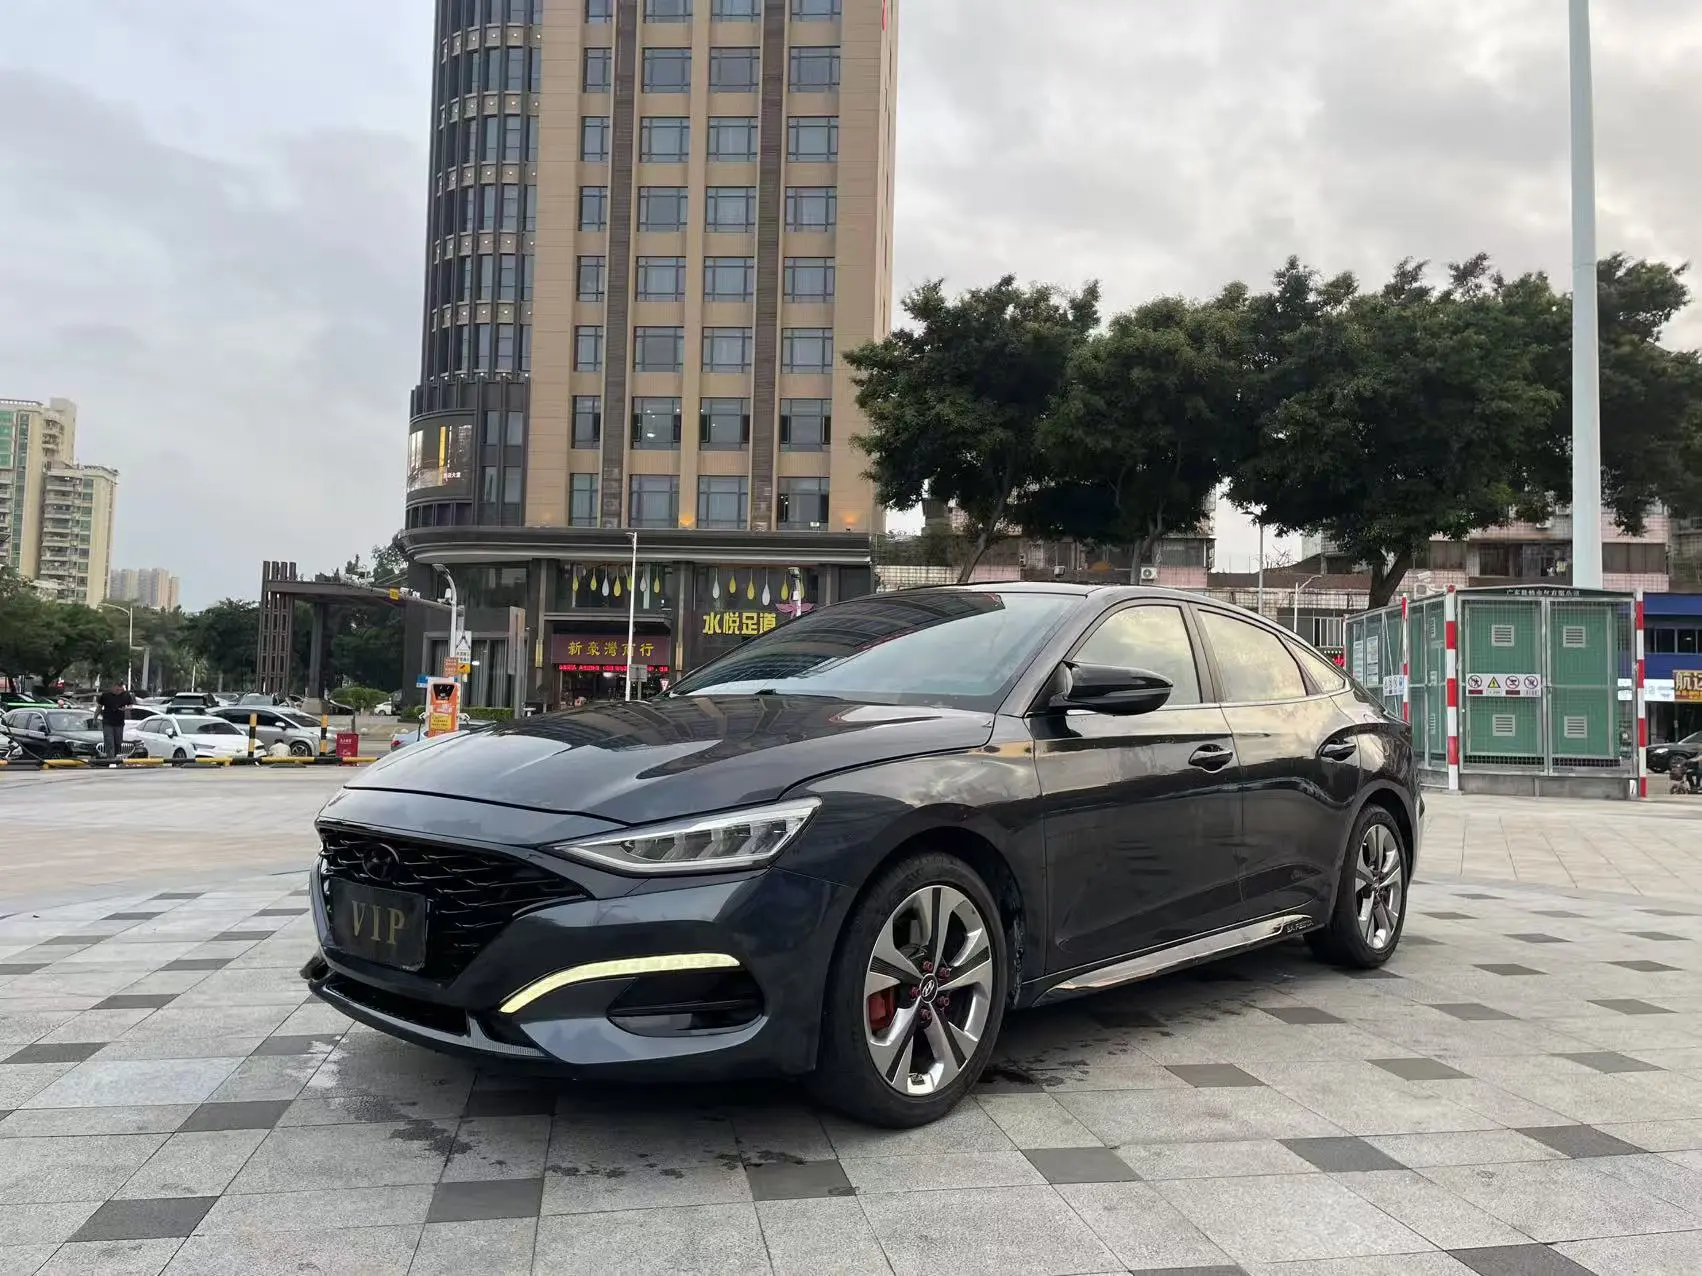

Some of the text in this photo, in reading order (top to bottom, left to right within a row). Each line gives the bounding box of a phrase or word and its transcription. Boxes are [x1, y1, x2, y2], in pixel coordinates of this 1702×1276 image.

[702, 612, 776, 634] 水悦足道
[351, 900, 406, 945] VIP
